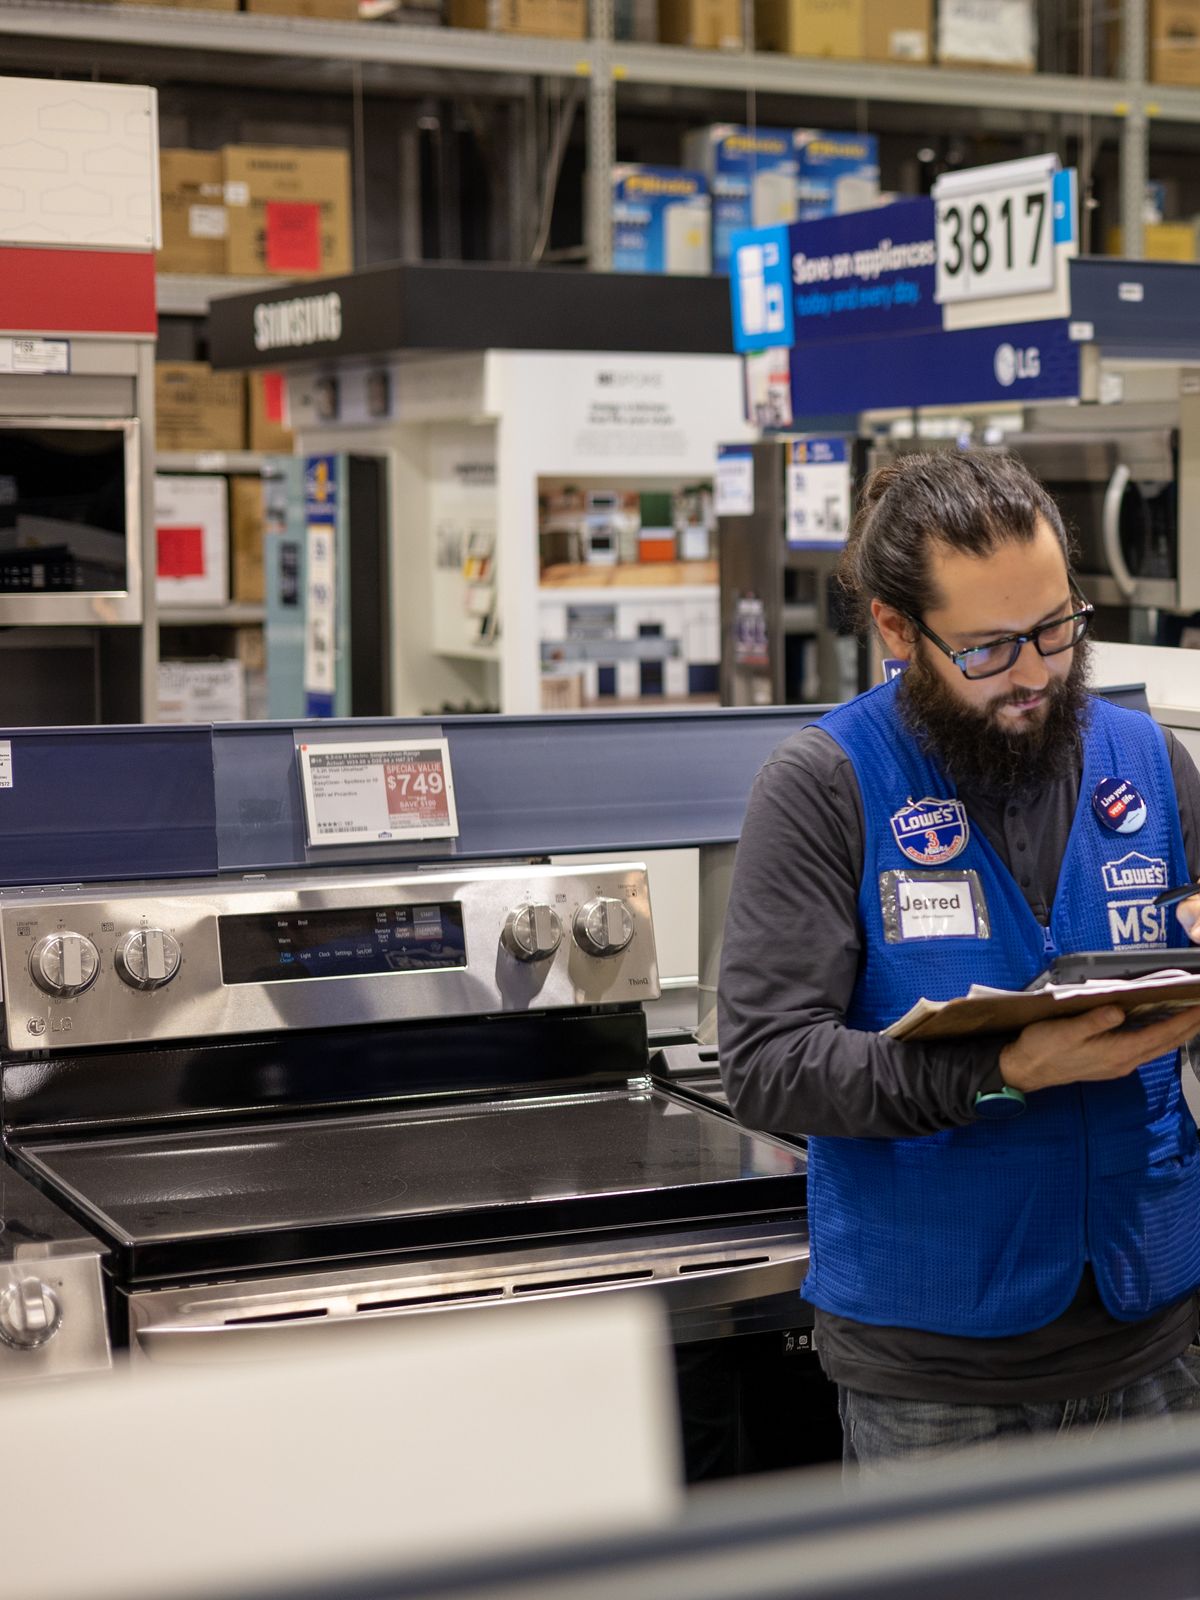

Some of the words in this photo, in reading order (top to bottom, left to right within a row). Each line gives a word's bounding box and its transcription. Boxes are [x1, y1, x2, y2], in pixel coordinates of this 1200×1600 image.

[942, 192, 1046, 276] 3817
[793, 252, 832, 285] Save
[253, 291, 342, 351] SAMSUNG
[1017, 347, 1041, 379] LG
[386, 763, 417, 774] SPECIAL
[418, 762, 442, 772] VALUE
[387, 773, 443, 795] $749
[899, 806, 954, 832] LOWE'S
[925, 830, 939, 848] 3
[1110, 865, 1164, 886] LOWE'S
[901, 894, 960, 911] Jerred
[628, 977, 648, 985] ThinQ
[51, 1016, 73, 1033] LG
